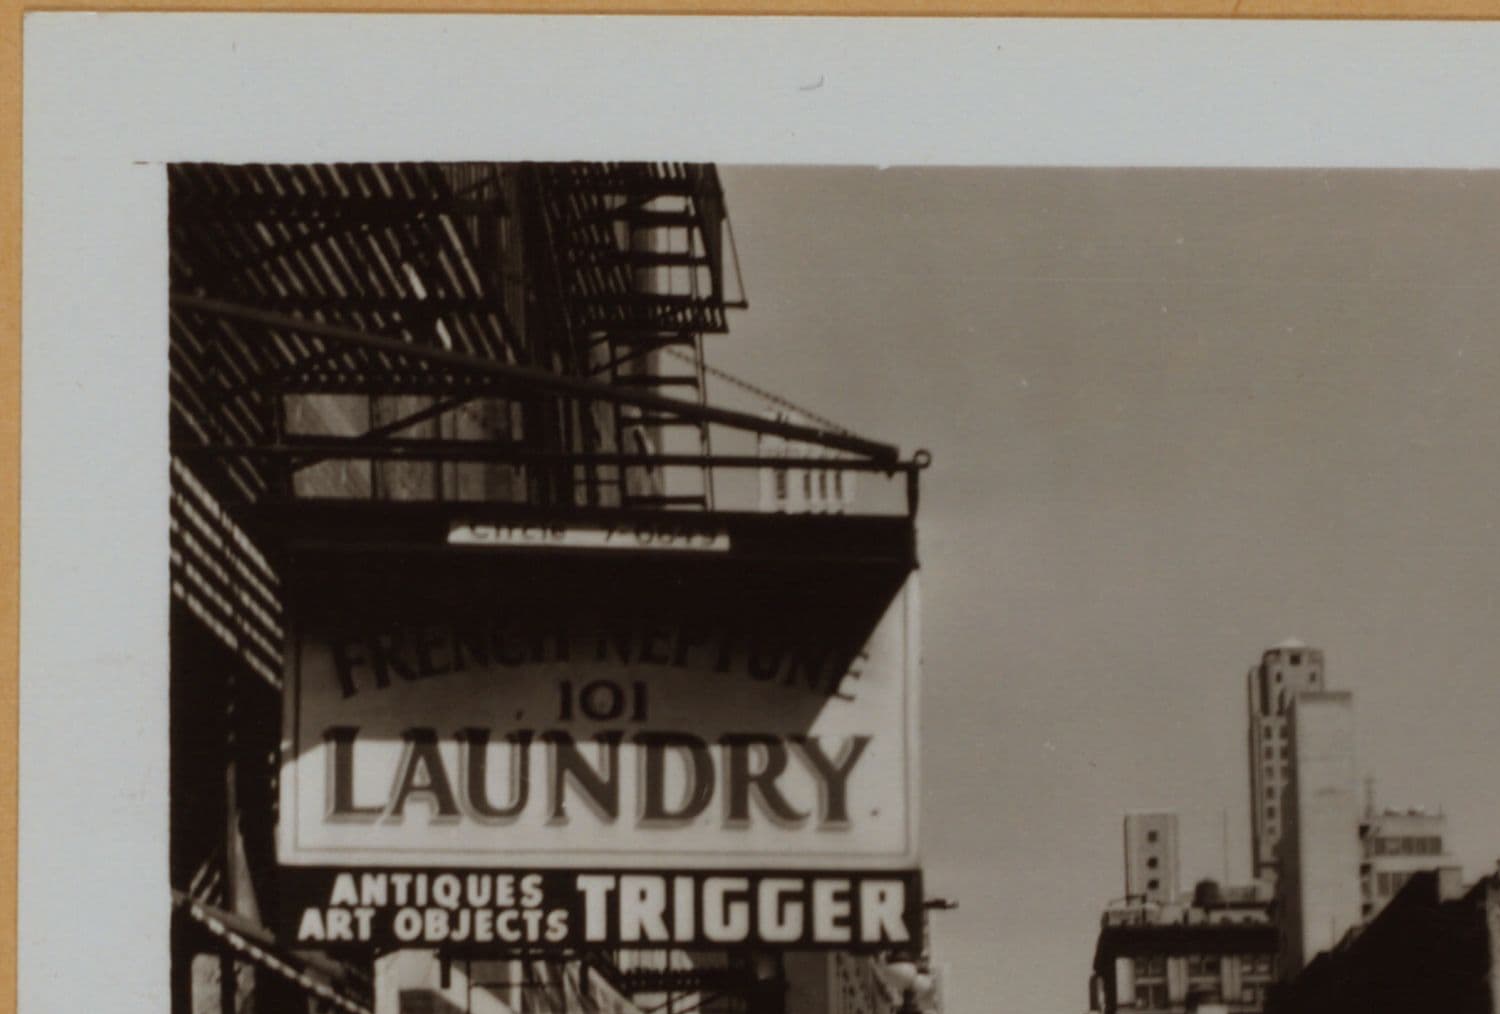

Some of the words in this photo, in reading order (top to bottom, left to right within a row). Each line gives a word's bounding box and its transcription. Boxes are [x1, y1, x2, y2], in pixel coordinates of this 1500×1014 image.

[321, 726, 874, 832] LAUNDRY
[329, 873, 544, 908] ANTIQUES
[577, 875, 910, 944] TRIGGER
[297, 908, 373, 942] ART
[398, 907, 569, 942] OBJECTS
